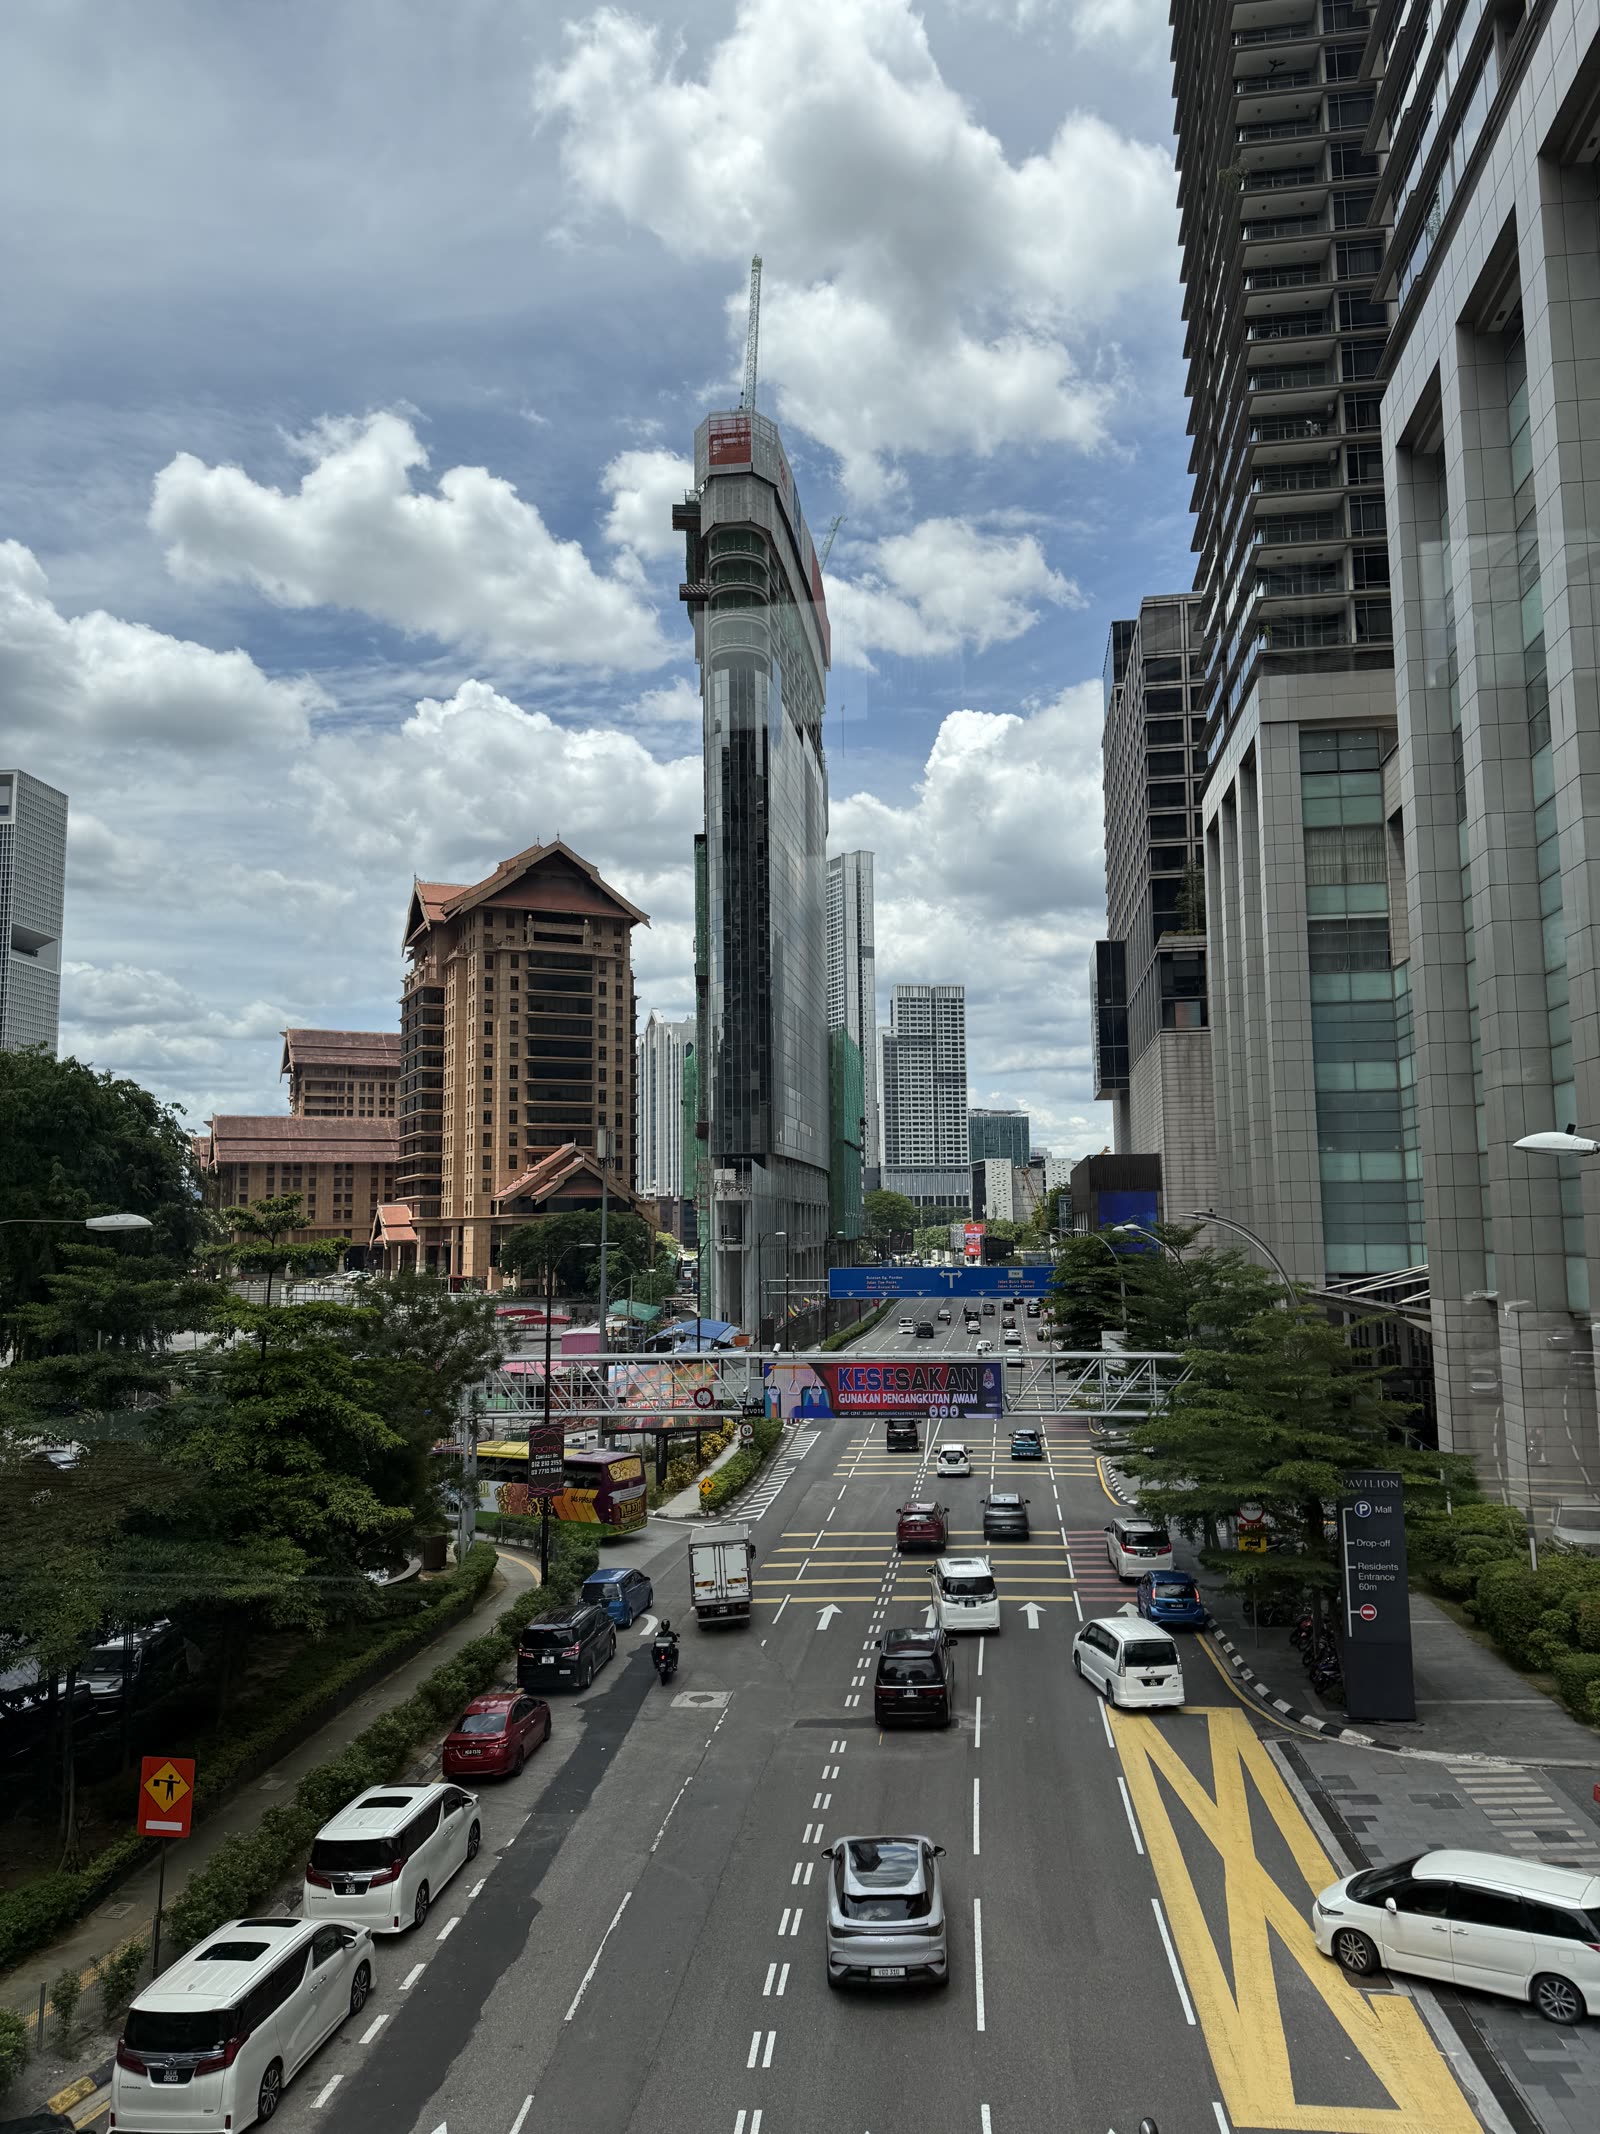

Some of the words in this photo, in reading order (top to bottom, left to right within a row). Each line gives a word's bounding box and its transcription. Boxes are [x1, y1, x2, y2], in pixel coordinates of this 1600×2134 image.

[837, 1367, 978, 1392] KESESAKAN
[838, 1393, 881, 1404] GUNAKAN
[882, 1393, 950, 1404] PENGANGKUTAN
[952, 1393, 978, 1404] AWAM
[1342, 1479, 1399, 1488] PAVILION
[1374, 1506, 1392, 1514] Mall
[1356, 1538, 1391, 1548] Drop-off
[1358, 1562, 1399, 1571] Residents
[1358, 1572, 1396, 1581] Entrance
[1358, 1582, 1377, 1591] 60m
